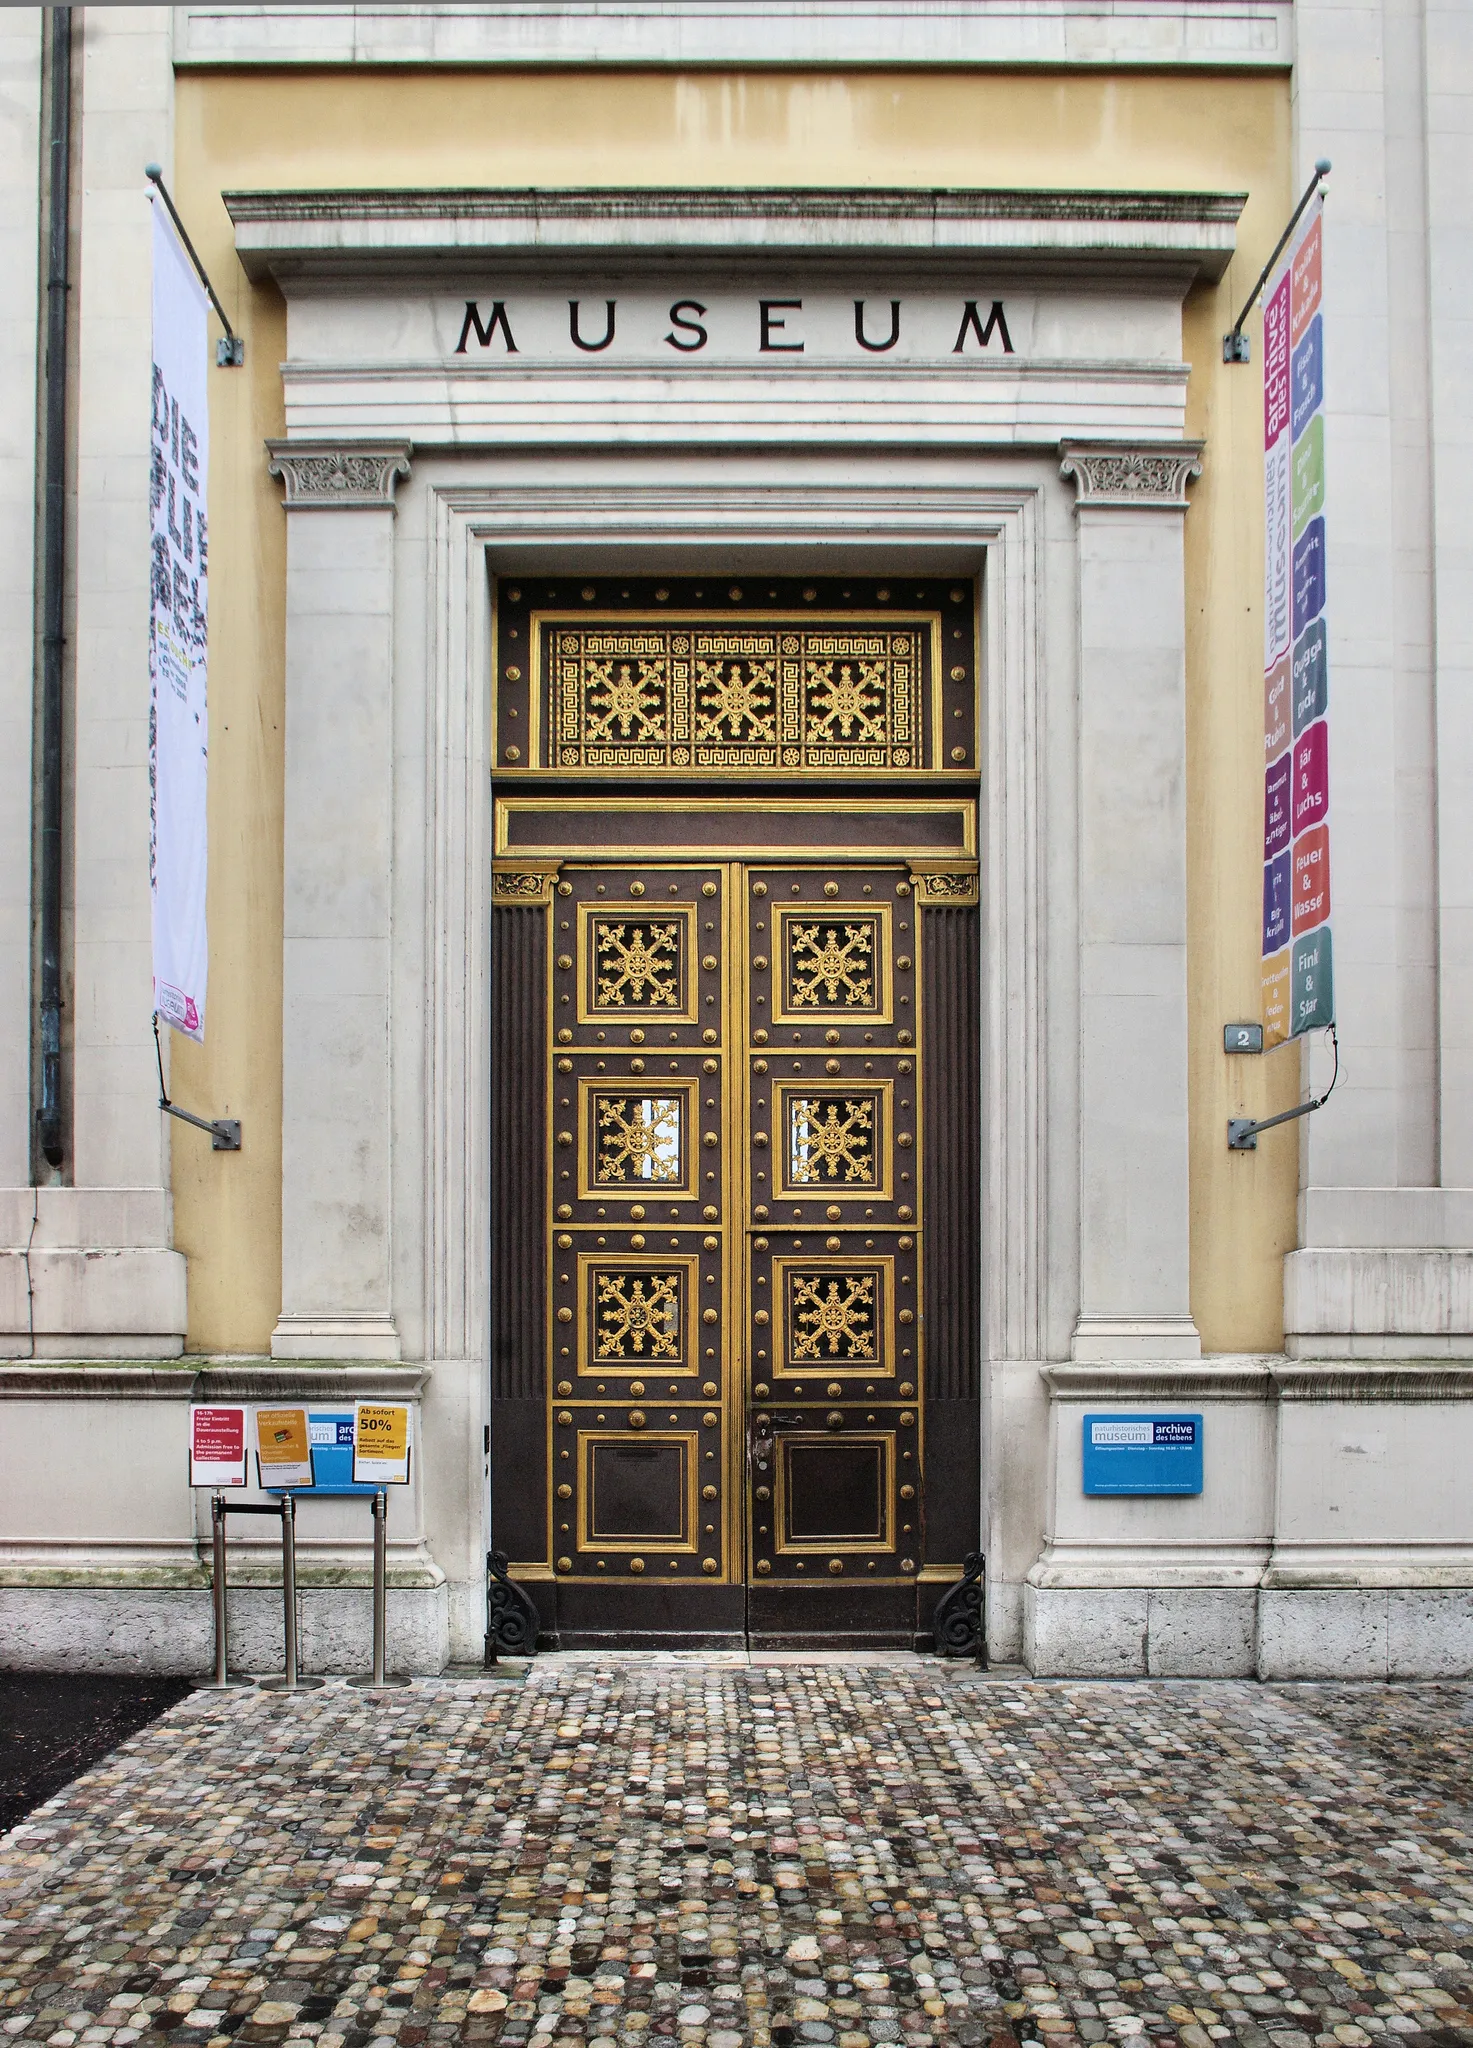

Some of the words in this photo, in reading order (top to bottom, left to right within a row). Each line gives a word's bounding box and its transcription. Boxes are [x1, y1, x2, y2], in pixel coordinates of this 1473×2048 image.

[454, 300, 1015, 354] MUSEUM
[1265, 304, 1279, 438] archive
[1297, 342, 1314, 379] Fisch
[1293, 382, 1317, 427] Frosch
[150, 360, 200, 497] DIE
[1273, 452, 1287, 643] museum
[1302, 768, 1309, 790] &
[1296, 847, 1323, 874] Feuer
[1302, 874, 1312, 891] &
[1294, 891, 1325, 921] Wasser
[1298, 949, 1320, 973] Fink
[1272, 988, 1279, 999] &
[1305, 975, 1314, 992] &
[1299, 998, 1319, 1018] Star
[1238, 1030, 1250, 1046] 2
[360, 1418, 392, 1431] 50%
[1094, 1423, 1150, 1432] naturhistorisches
[1155, 1423, 1193, 1434] archive
[339, 1434, 352, 1442] des
[1094, 1431, 1147, 1441] museum
